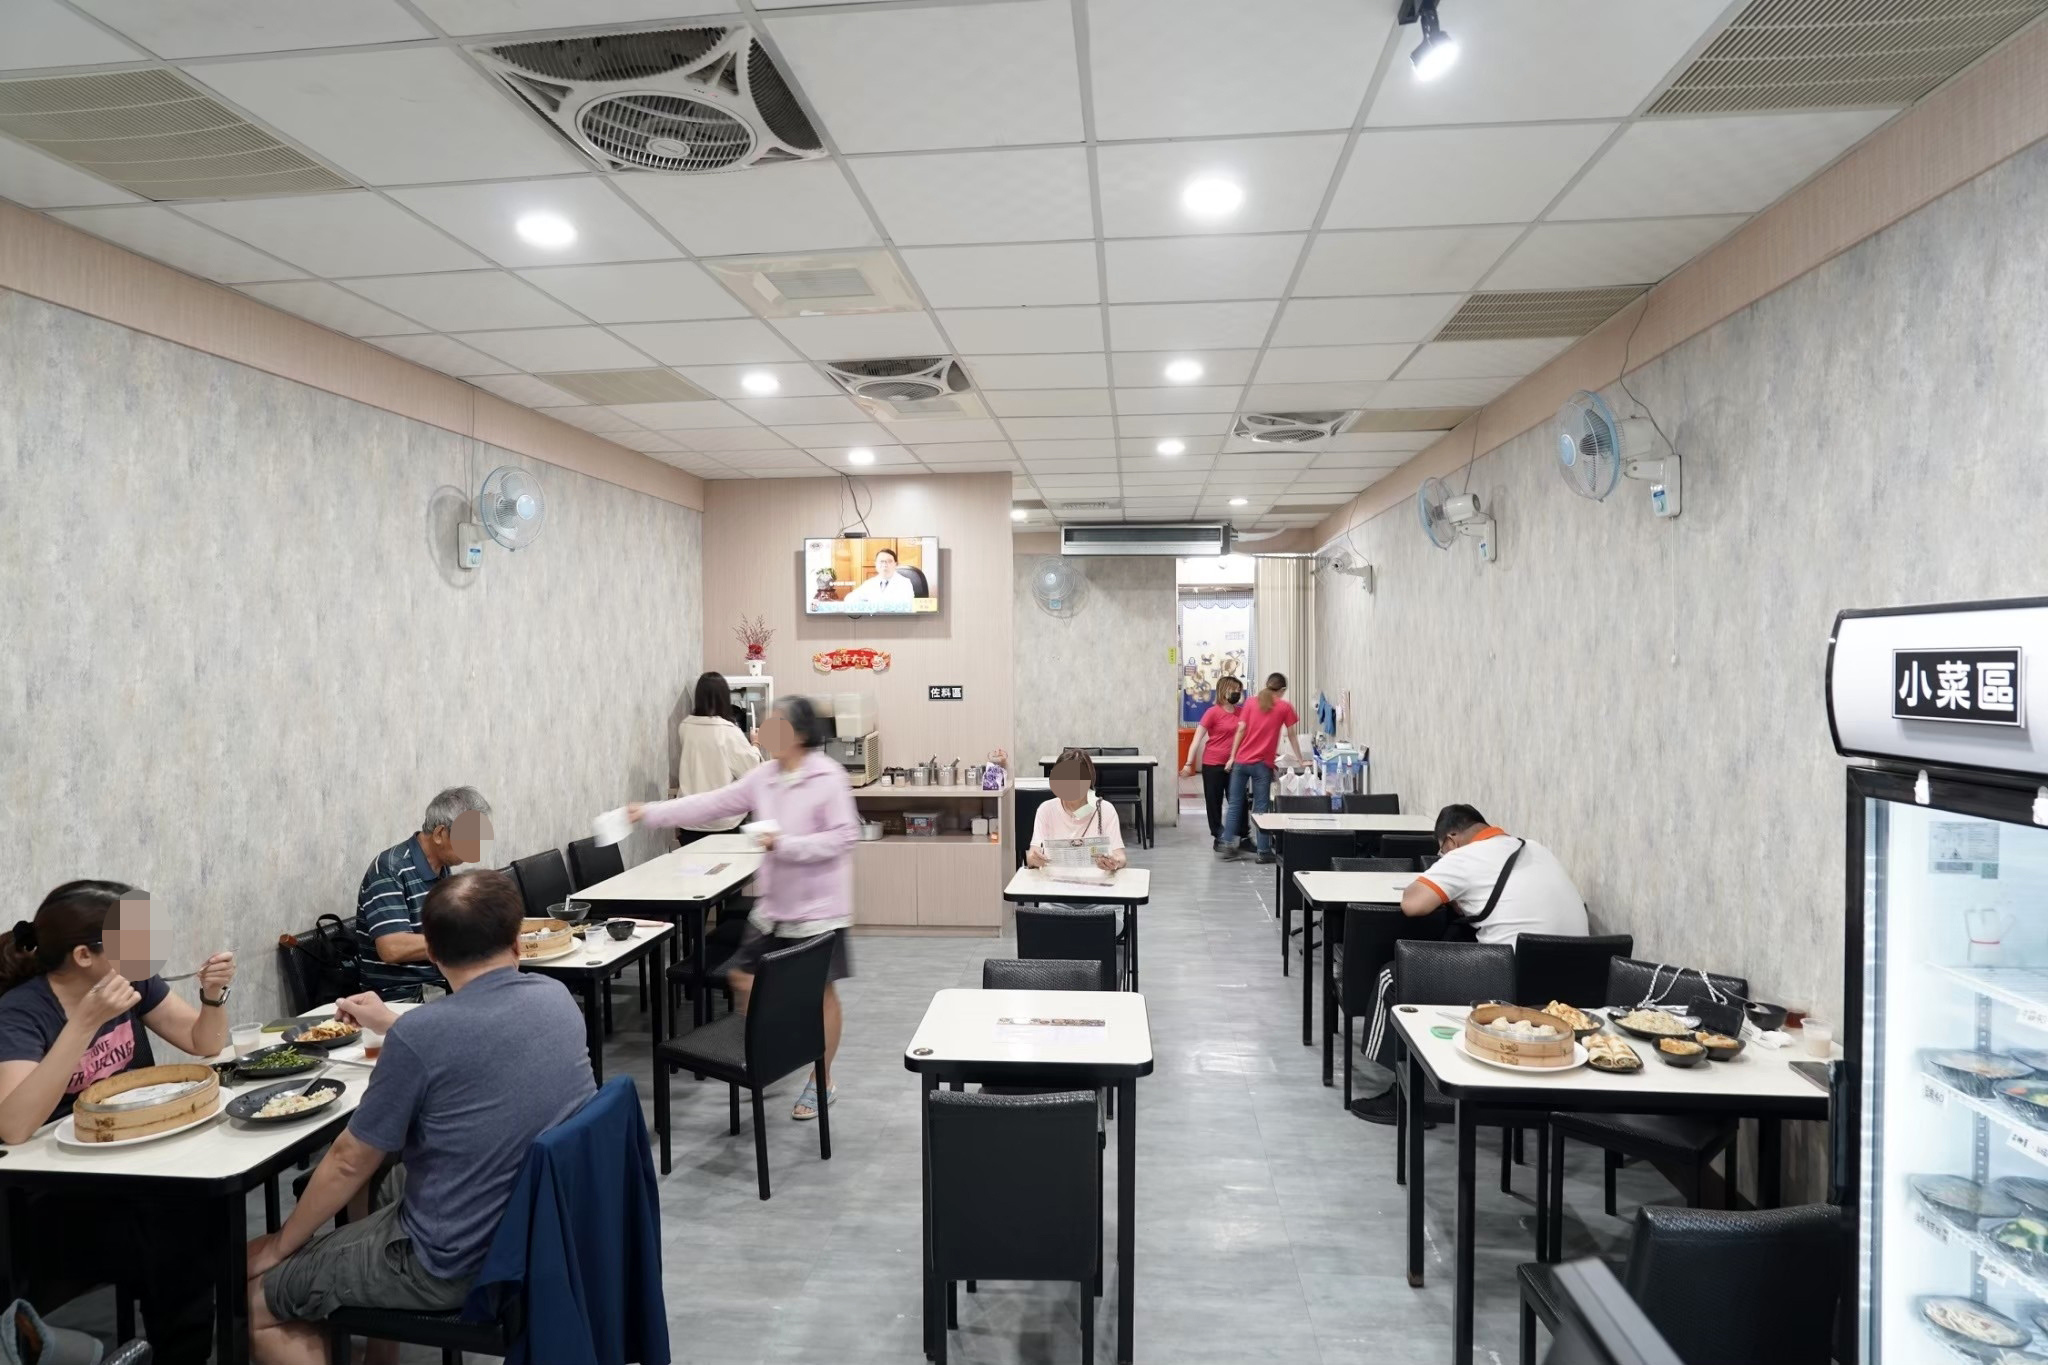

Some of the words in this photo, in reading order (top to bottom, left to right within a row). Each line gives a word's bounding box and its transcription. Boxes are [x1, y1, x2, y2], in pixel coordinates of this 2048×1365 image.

[930, 687, 961, 698] 佐料區
[1898, 660, 2015, 712] 小菜區
